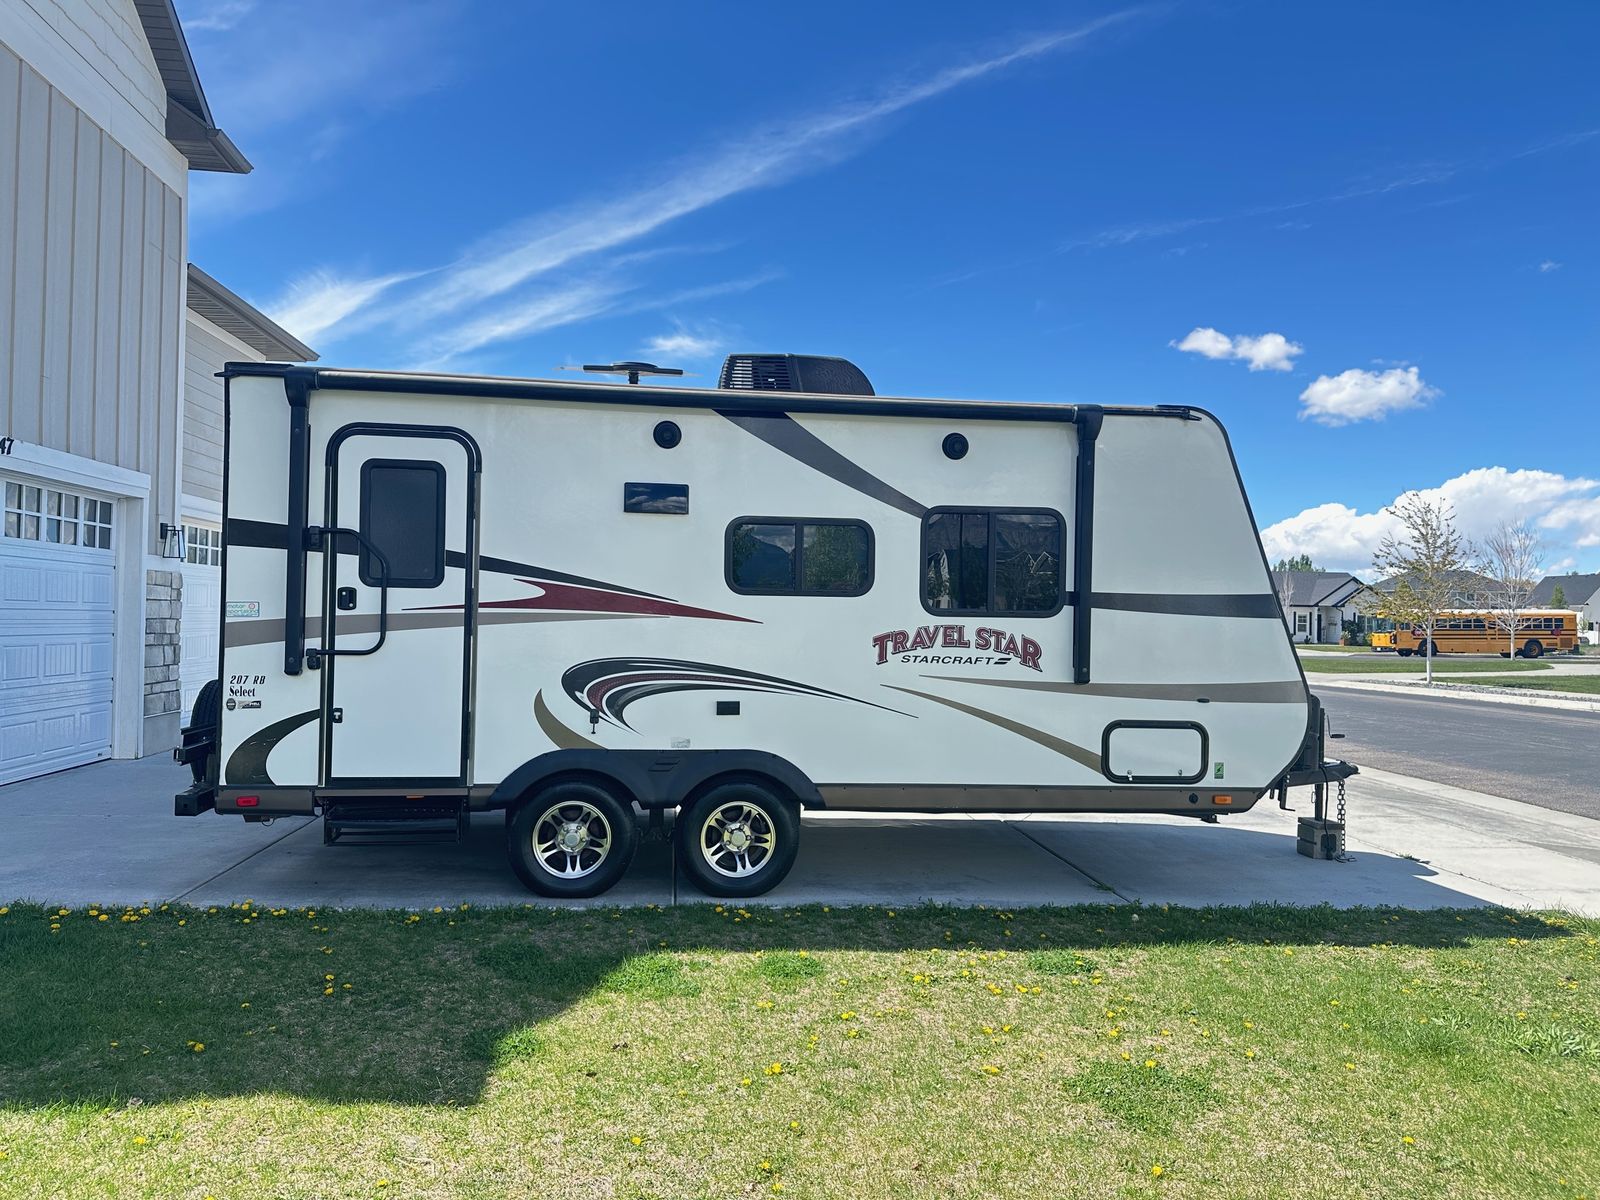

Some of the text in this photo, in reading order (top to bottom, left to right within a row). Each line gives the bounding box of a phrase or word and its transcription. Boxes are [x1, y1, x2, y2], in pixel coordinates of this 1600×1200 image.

[872, 624, 1043, 672] TRAVEL STAR
[901, 655, 994, 665] STARCRAFT
[230, 675, 266, 684] 207 RB
[229, 685, 255, 697] Select
